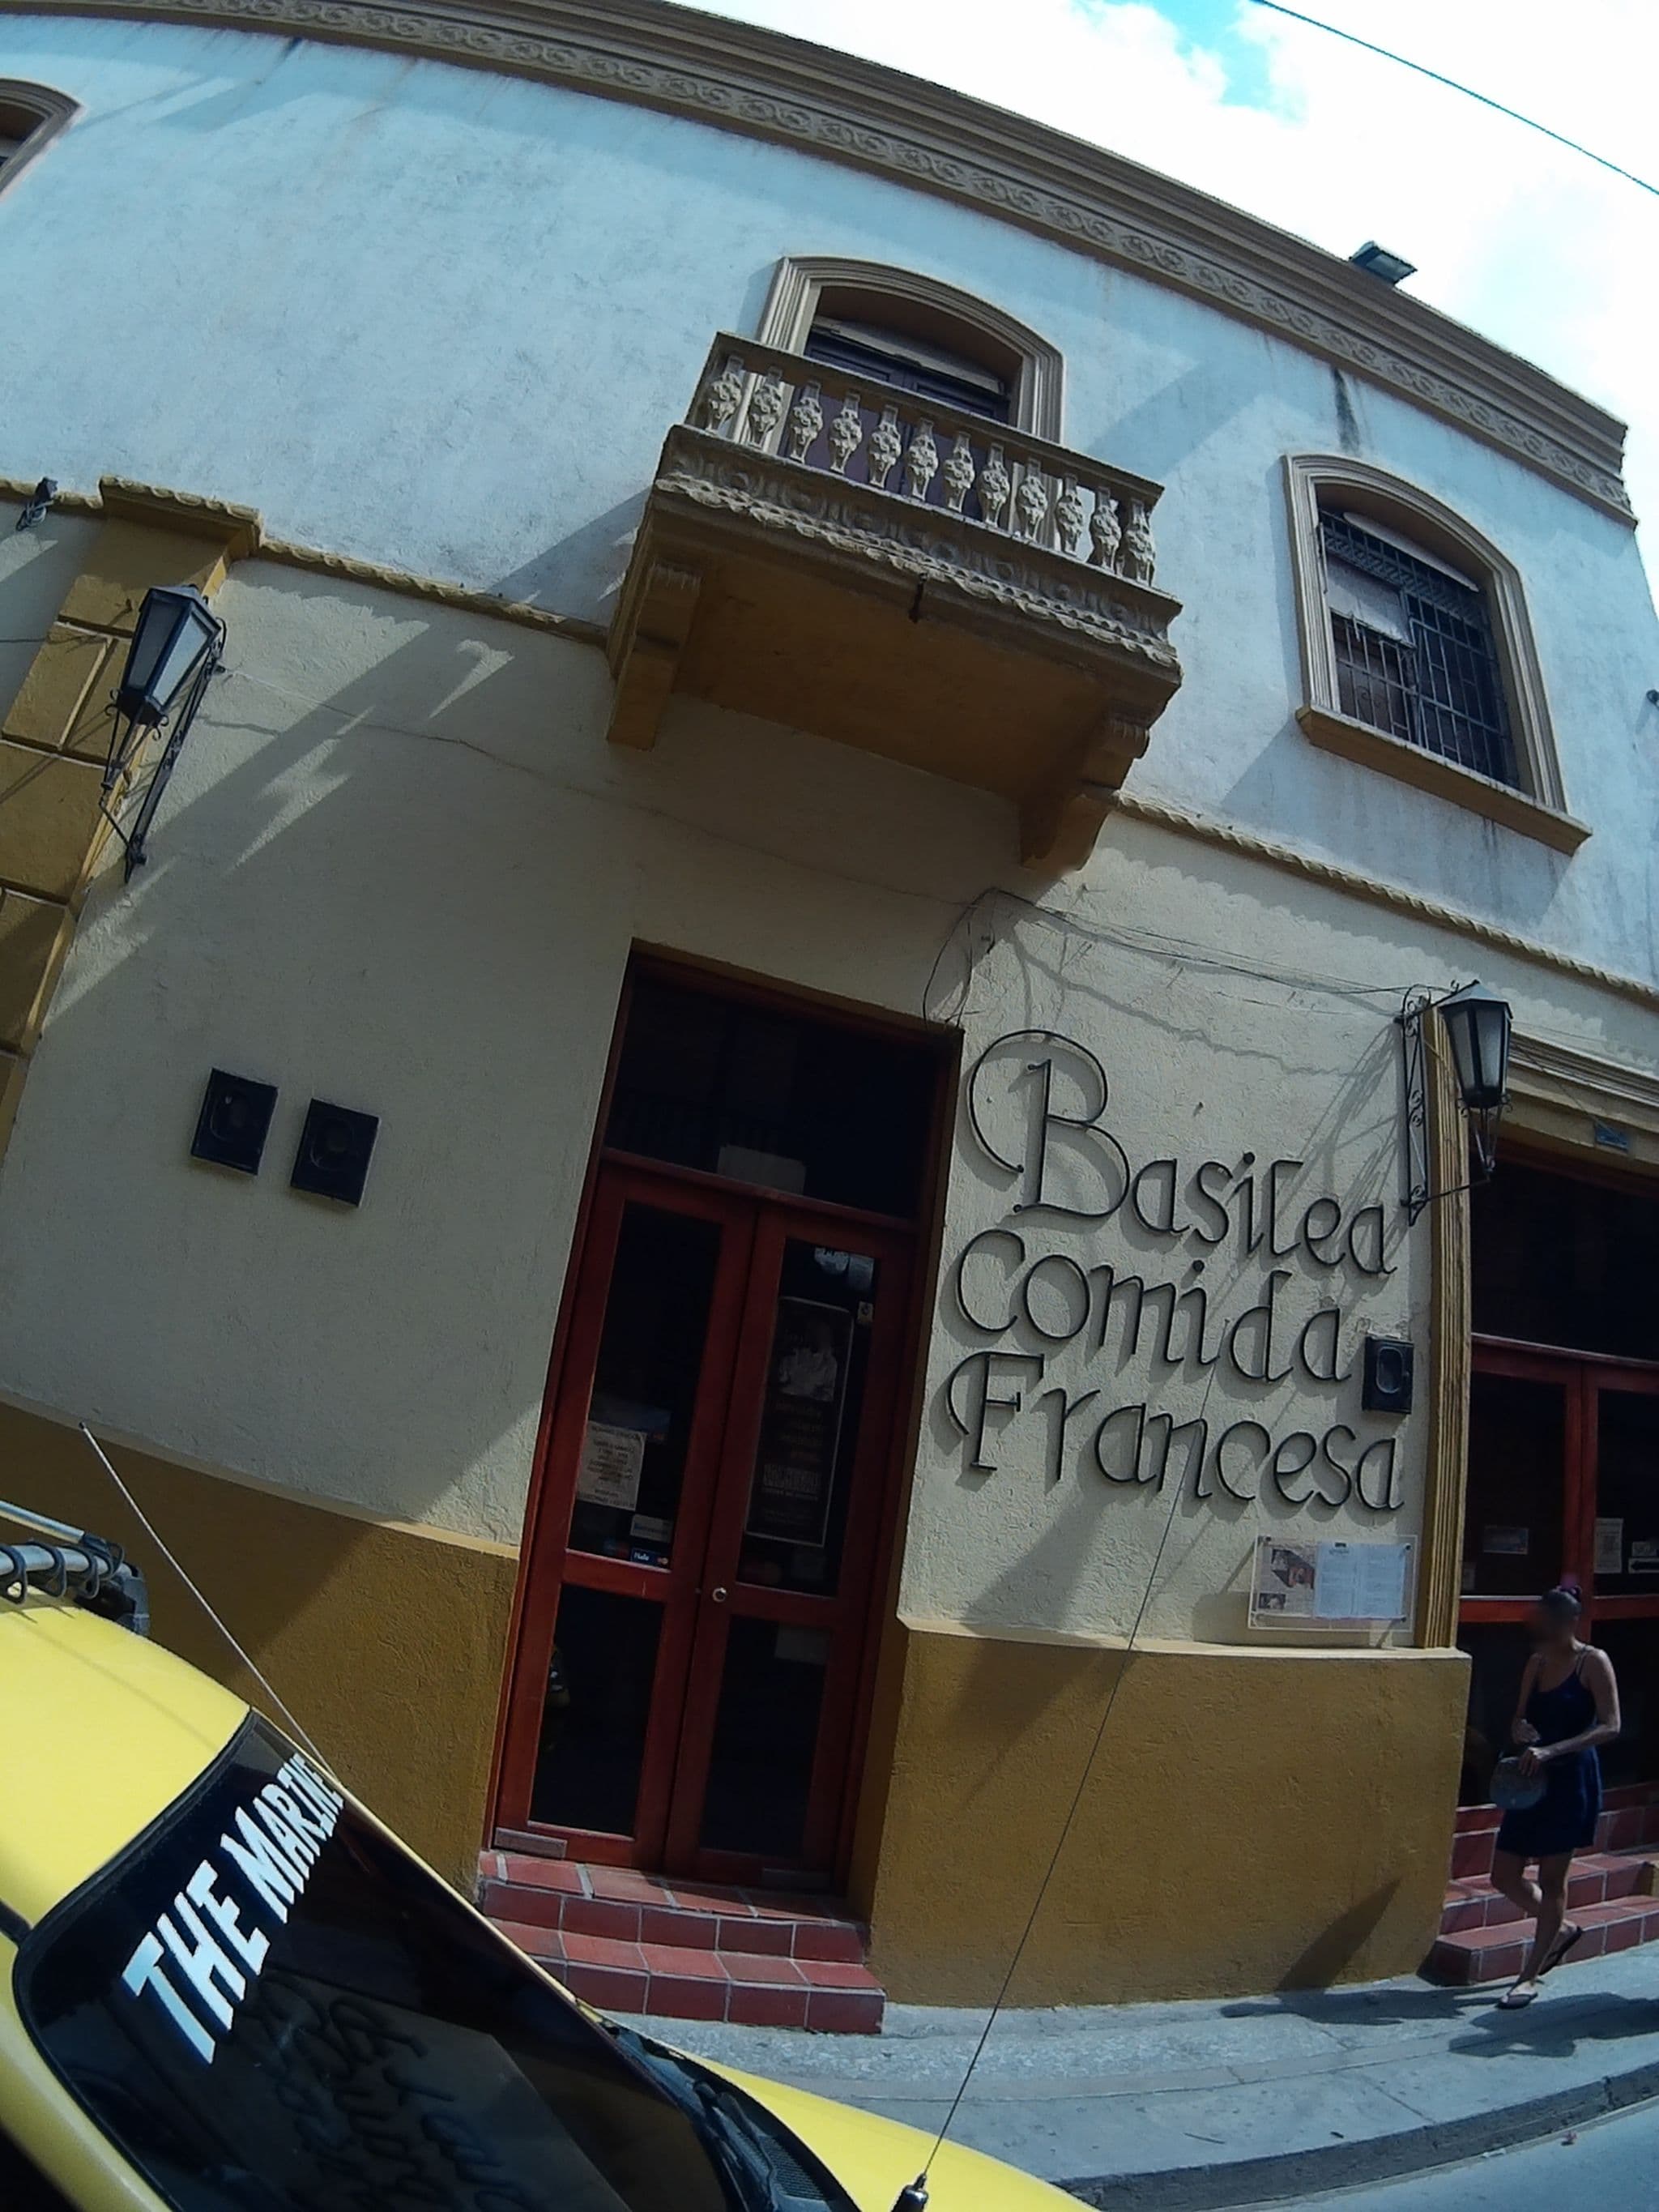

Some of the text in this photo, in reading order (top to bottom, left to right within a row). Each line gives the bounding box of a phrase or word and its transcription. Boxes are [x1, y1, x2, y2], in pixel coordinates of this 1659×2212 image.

[970, 1030, 1397, 1275] Basilea
[957, 1228, 1353, 1382] Comida
[948, 1352, 1405, 1511] Francesa
[122, 1753, 343, 2065] THE MARINE
